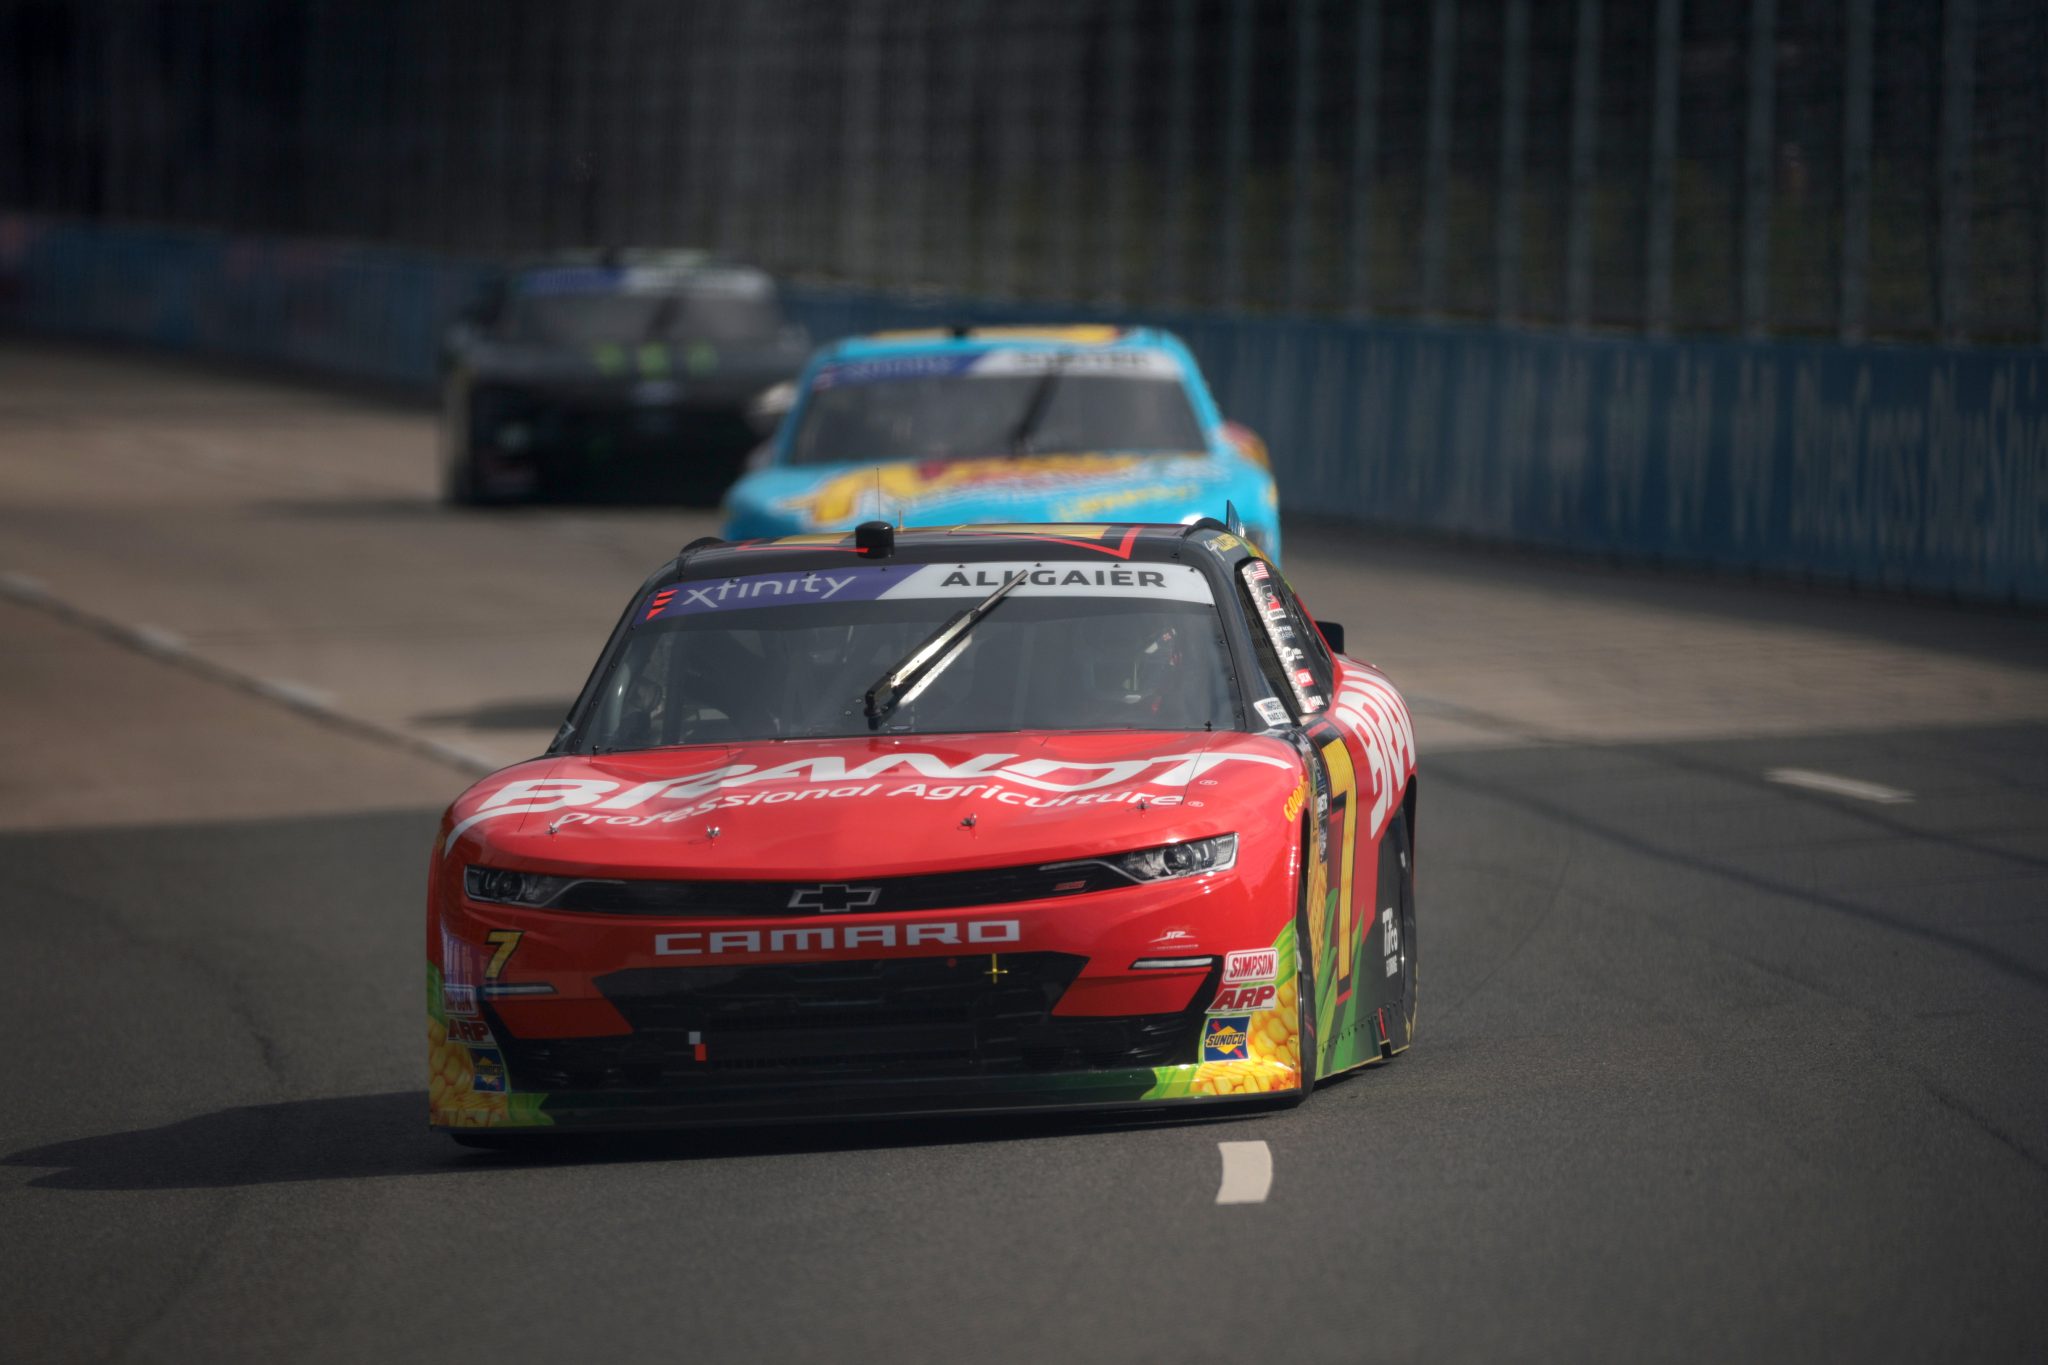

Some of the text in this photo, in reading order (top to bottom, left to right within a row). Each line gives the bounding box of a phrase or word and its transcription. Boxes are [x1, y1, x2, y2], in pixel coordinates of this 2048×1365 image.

[681, 573, 857, 608] xfinity
[940, 569, 1167, 589] ALLGAIER
[446, 752, 1293, 857] BRANDT
[552, 783, 1184, 827] Professional Agriculture
[1322, 737, 1357, 981] 7
[484, 930, 524, 979] 7
[655, 920, 1020, 955] CAMARO
[1229, 954, 1274, 978] SIMPSON
[1210, 984, 1276, 1010] ARP
[448, 1018, 489, 1041] ARP
[1206, 1033, 1245, 1047] SUNOCO
